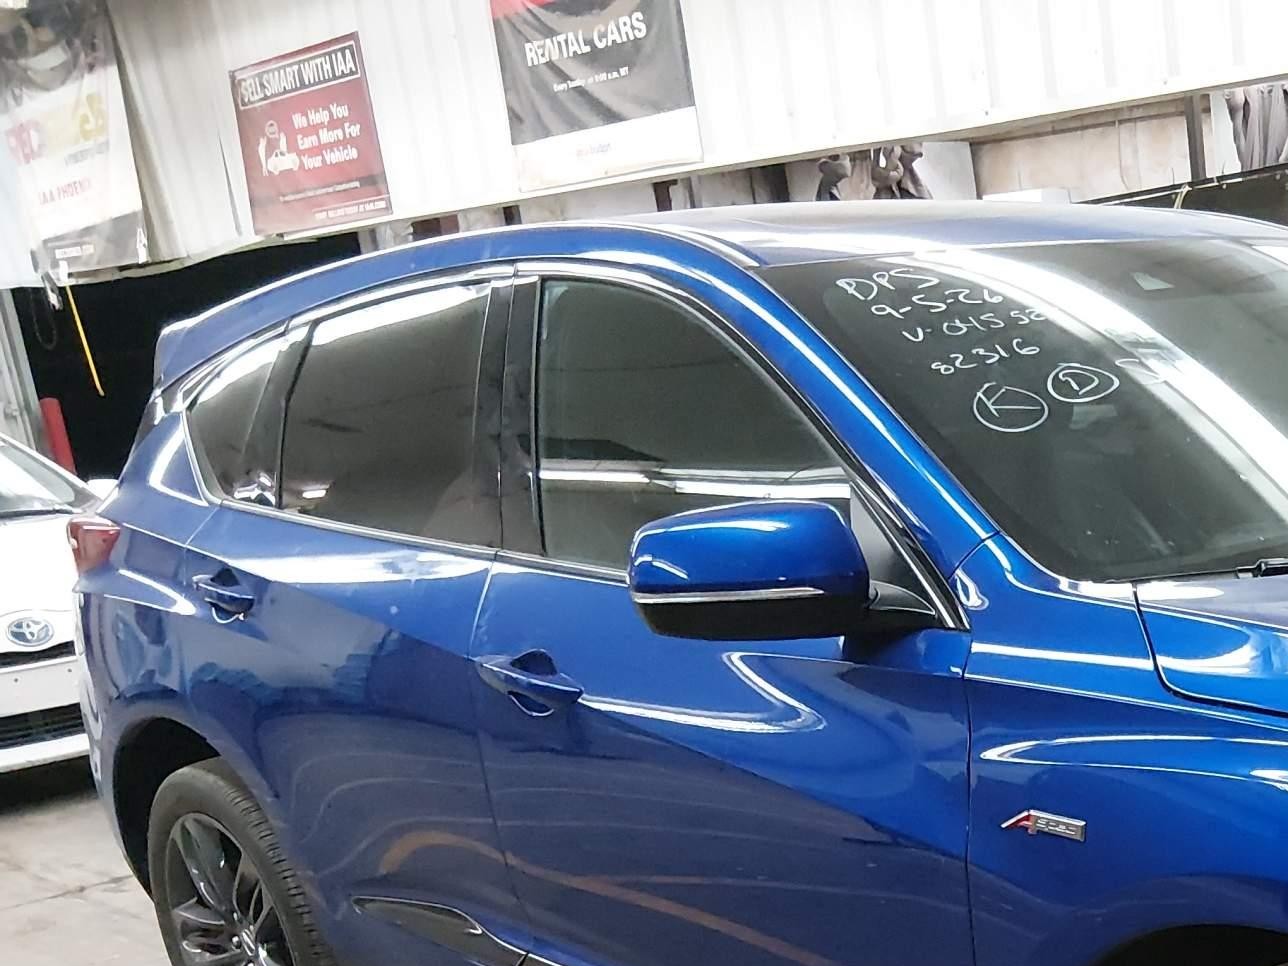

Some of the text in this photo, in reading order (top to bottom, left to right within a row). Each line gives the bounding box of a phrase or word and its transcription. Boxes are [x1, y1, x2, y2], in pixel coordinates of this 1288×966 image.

[524, 11, 647, 67] RENTAL CARS
[240, 49, 356, 102] SELL SMART WITH IAA
[292, 103, 350, 130] We Help You
[297, 122, 361, 150] Earn More For
[301, 144, 358, 171] Your Vehicle
[930, 337, 1041, 375] 82316
